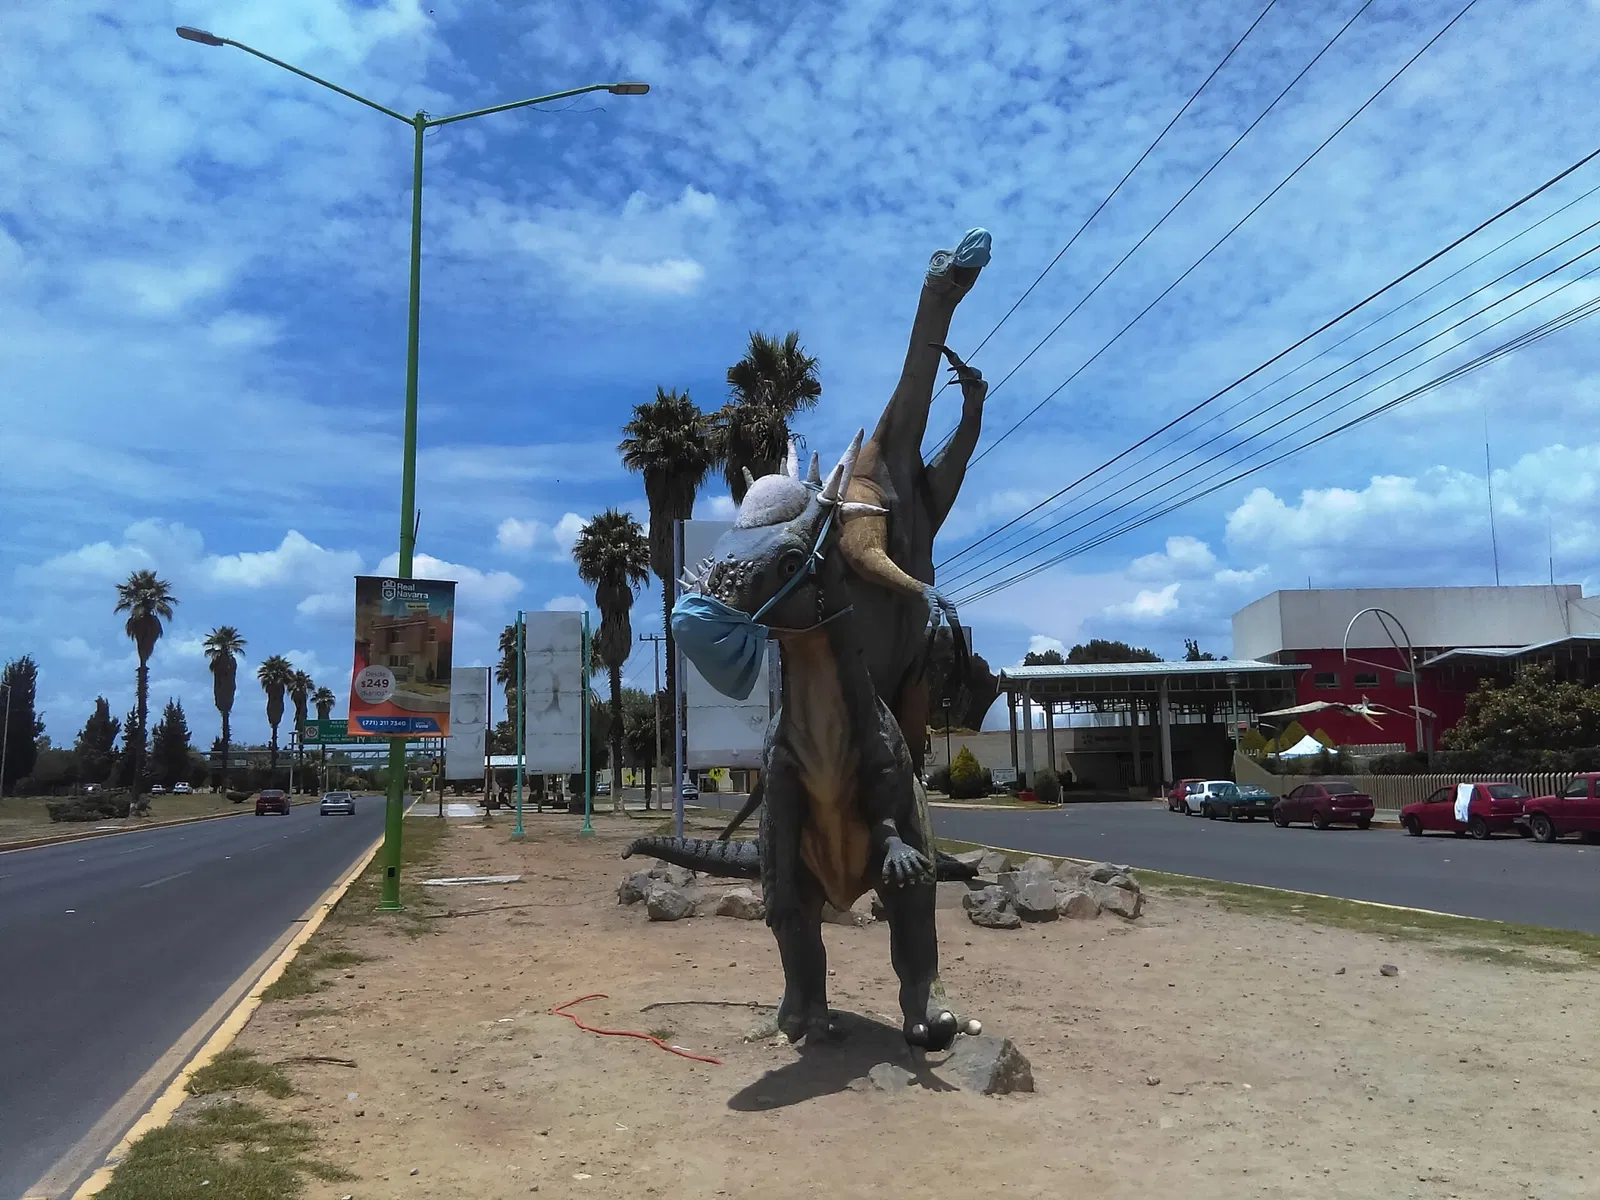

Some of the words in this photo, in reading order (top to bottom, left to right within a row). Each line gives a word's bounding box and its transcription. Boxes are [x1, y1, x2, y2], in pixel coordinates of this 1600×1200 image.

[397, 583, 415, 591] Real
[397, 591, 429, 599] Navarra
[361, 678, 390, 688] $249
